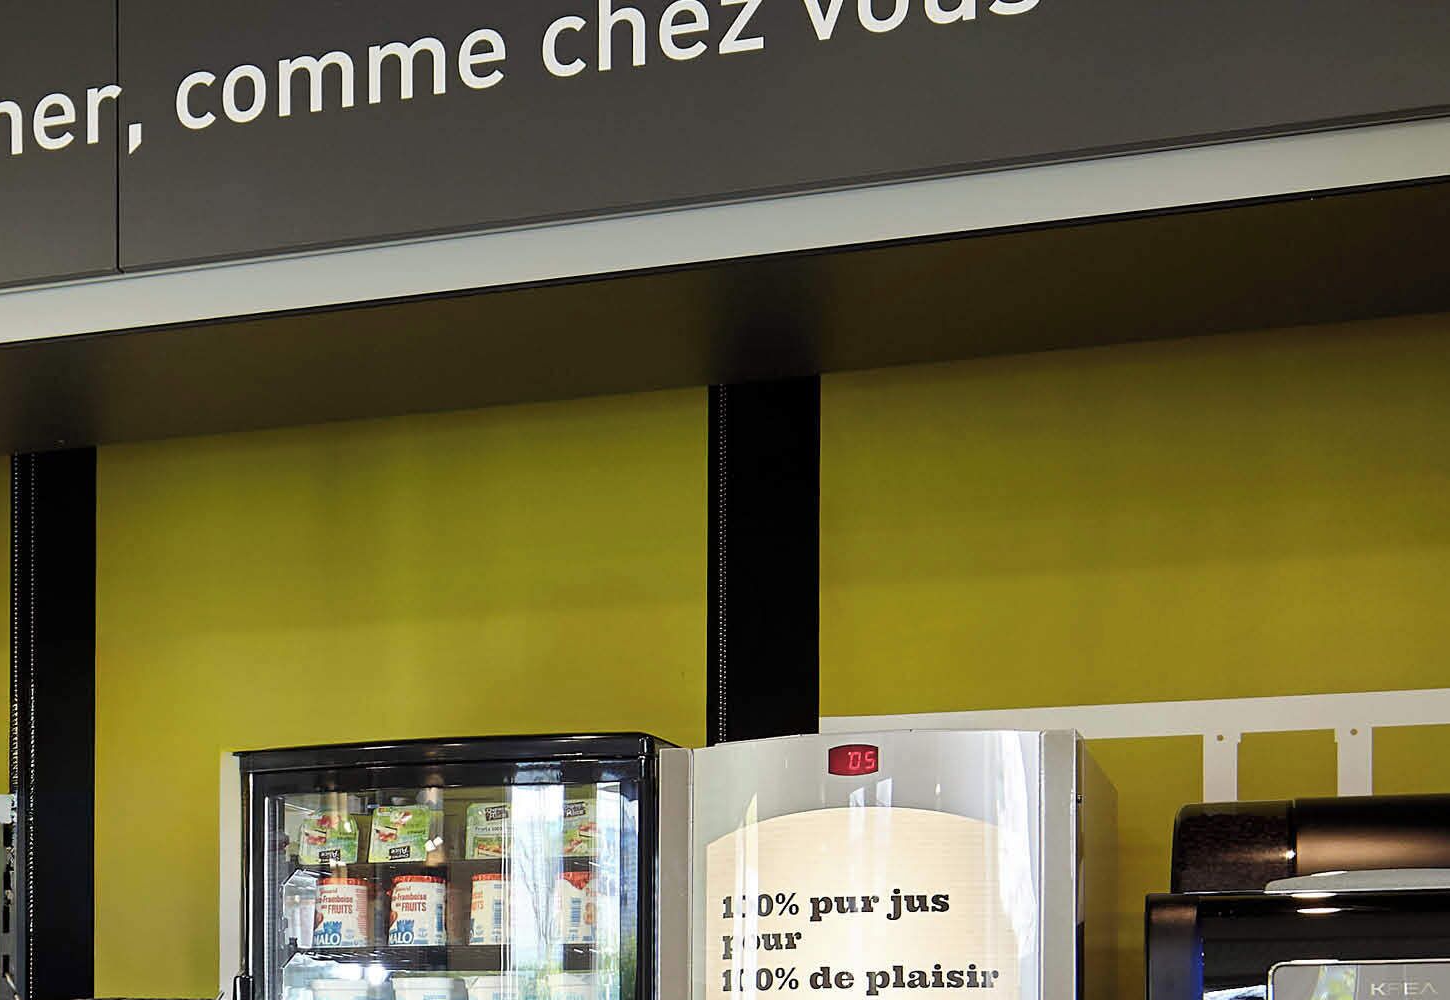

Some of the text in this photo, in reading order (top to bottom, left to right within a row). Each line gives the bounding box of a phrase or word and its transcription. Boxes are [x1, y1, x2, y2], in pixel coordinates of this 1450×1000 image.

[175, 28, 506, 130] comme
[541, 0, 765, 78] chez
[801, 0, 1044, 42] vo
[722, 888, 950, 922] 10% pur jus
[809, 966, 855, 990] de
[866, 963, 999, 996] plaisir
